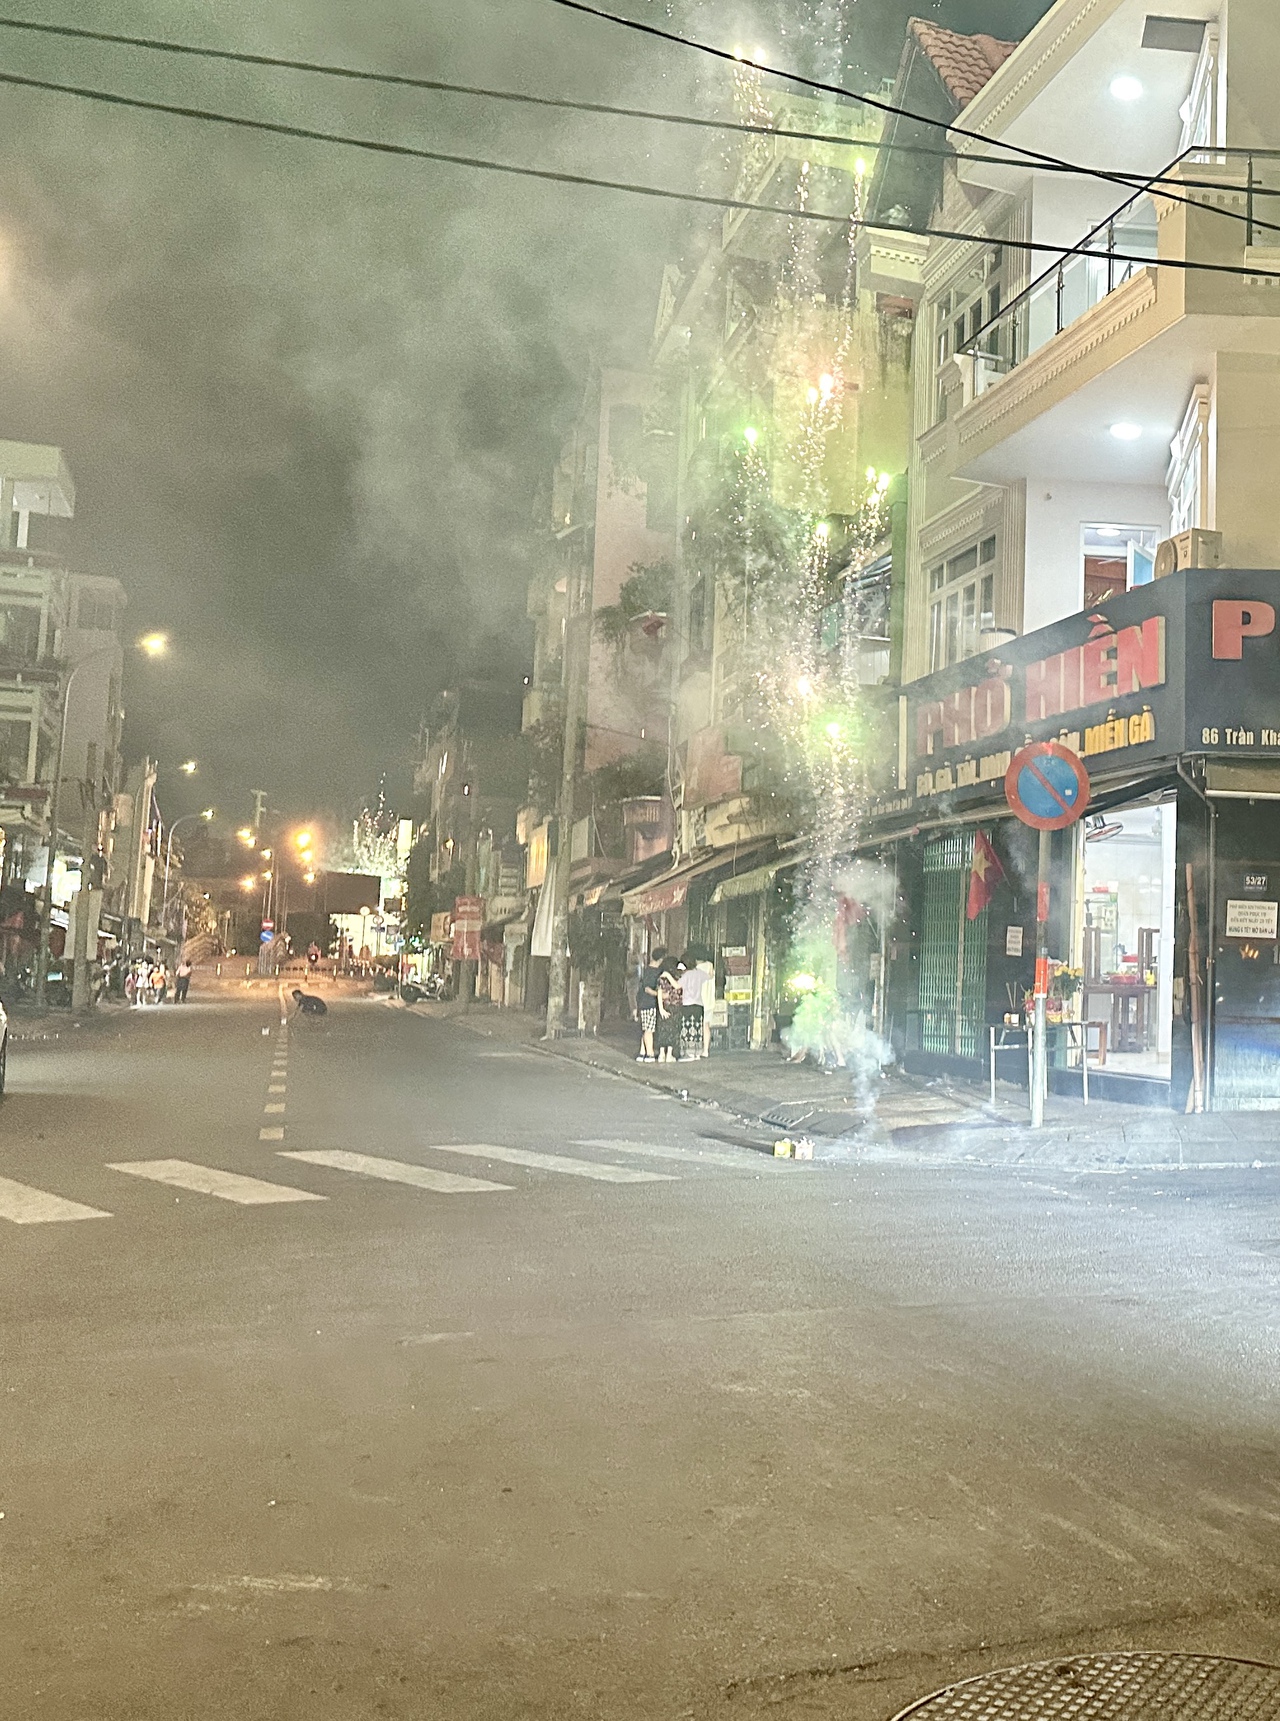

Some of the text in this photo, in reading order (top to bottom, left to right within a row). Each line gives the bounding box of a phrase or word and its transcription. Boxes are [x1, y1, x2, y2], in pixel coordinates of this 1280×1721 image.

[916, 614, 1166, 756] PHỞ HIỀN
[1085, 708, 1128, 755] MIẾN
[1129, 705, 1155, 744] GÀ
[1202, 727, 1218, 744] 86
[1226, 726, 1254, 745] Trần
[1246, 876, 1266, 884] 53/27
